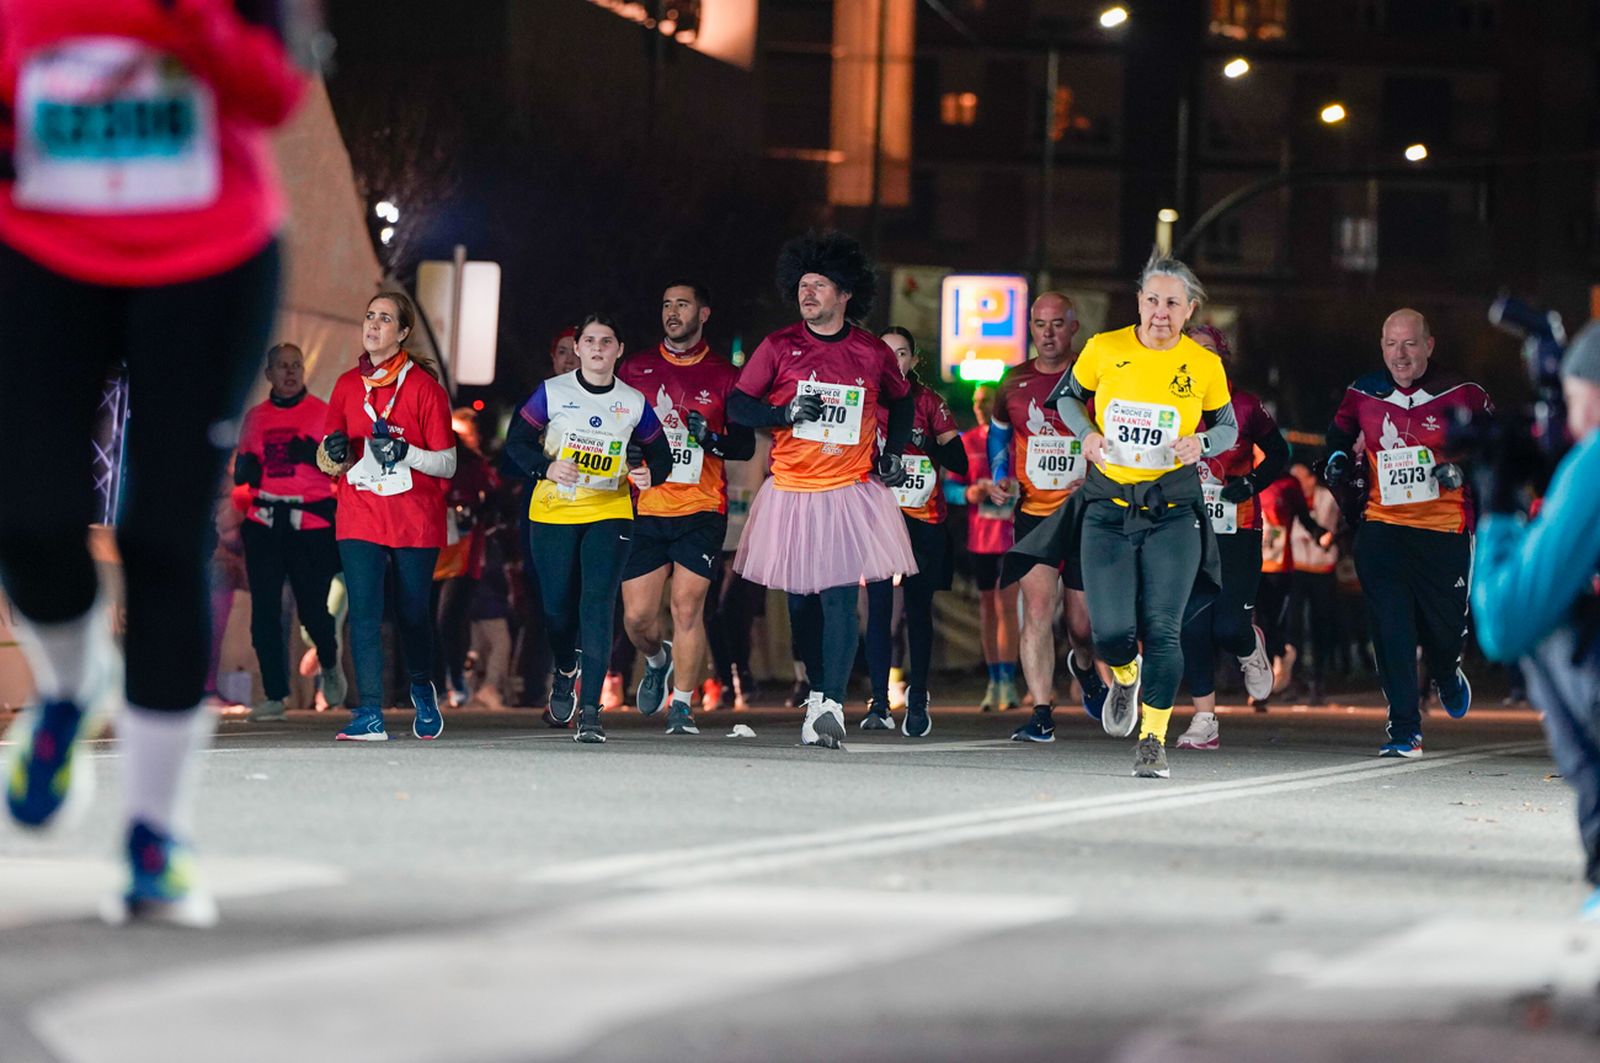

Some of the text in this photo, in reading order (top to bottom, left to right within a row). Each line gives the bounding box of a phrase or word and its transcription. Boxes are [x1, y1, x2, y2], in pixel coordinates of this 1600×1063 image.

[663, 413, 679, 429] 43
[820, 404, 847, 424] 170
[1118, 425, 1163, 446] 3479
[567, 442, 582, 451] SAN
[571, 451, 613, 472] 4400
[672, 448, 693, 465] 59
[1038, 455, 1076, 472] 4097
[905, 474, 925, 490] 55
[1388, 466, 1426, 486] 2573
[1205, 502, 1224, 519] 68
